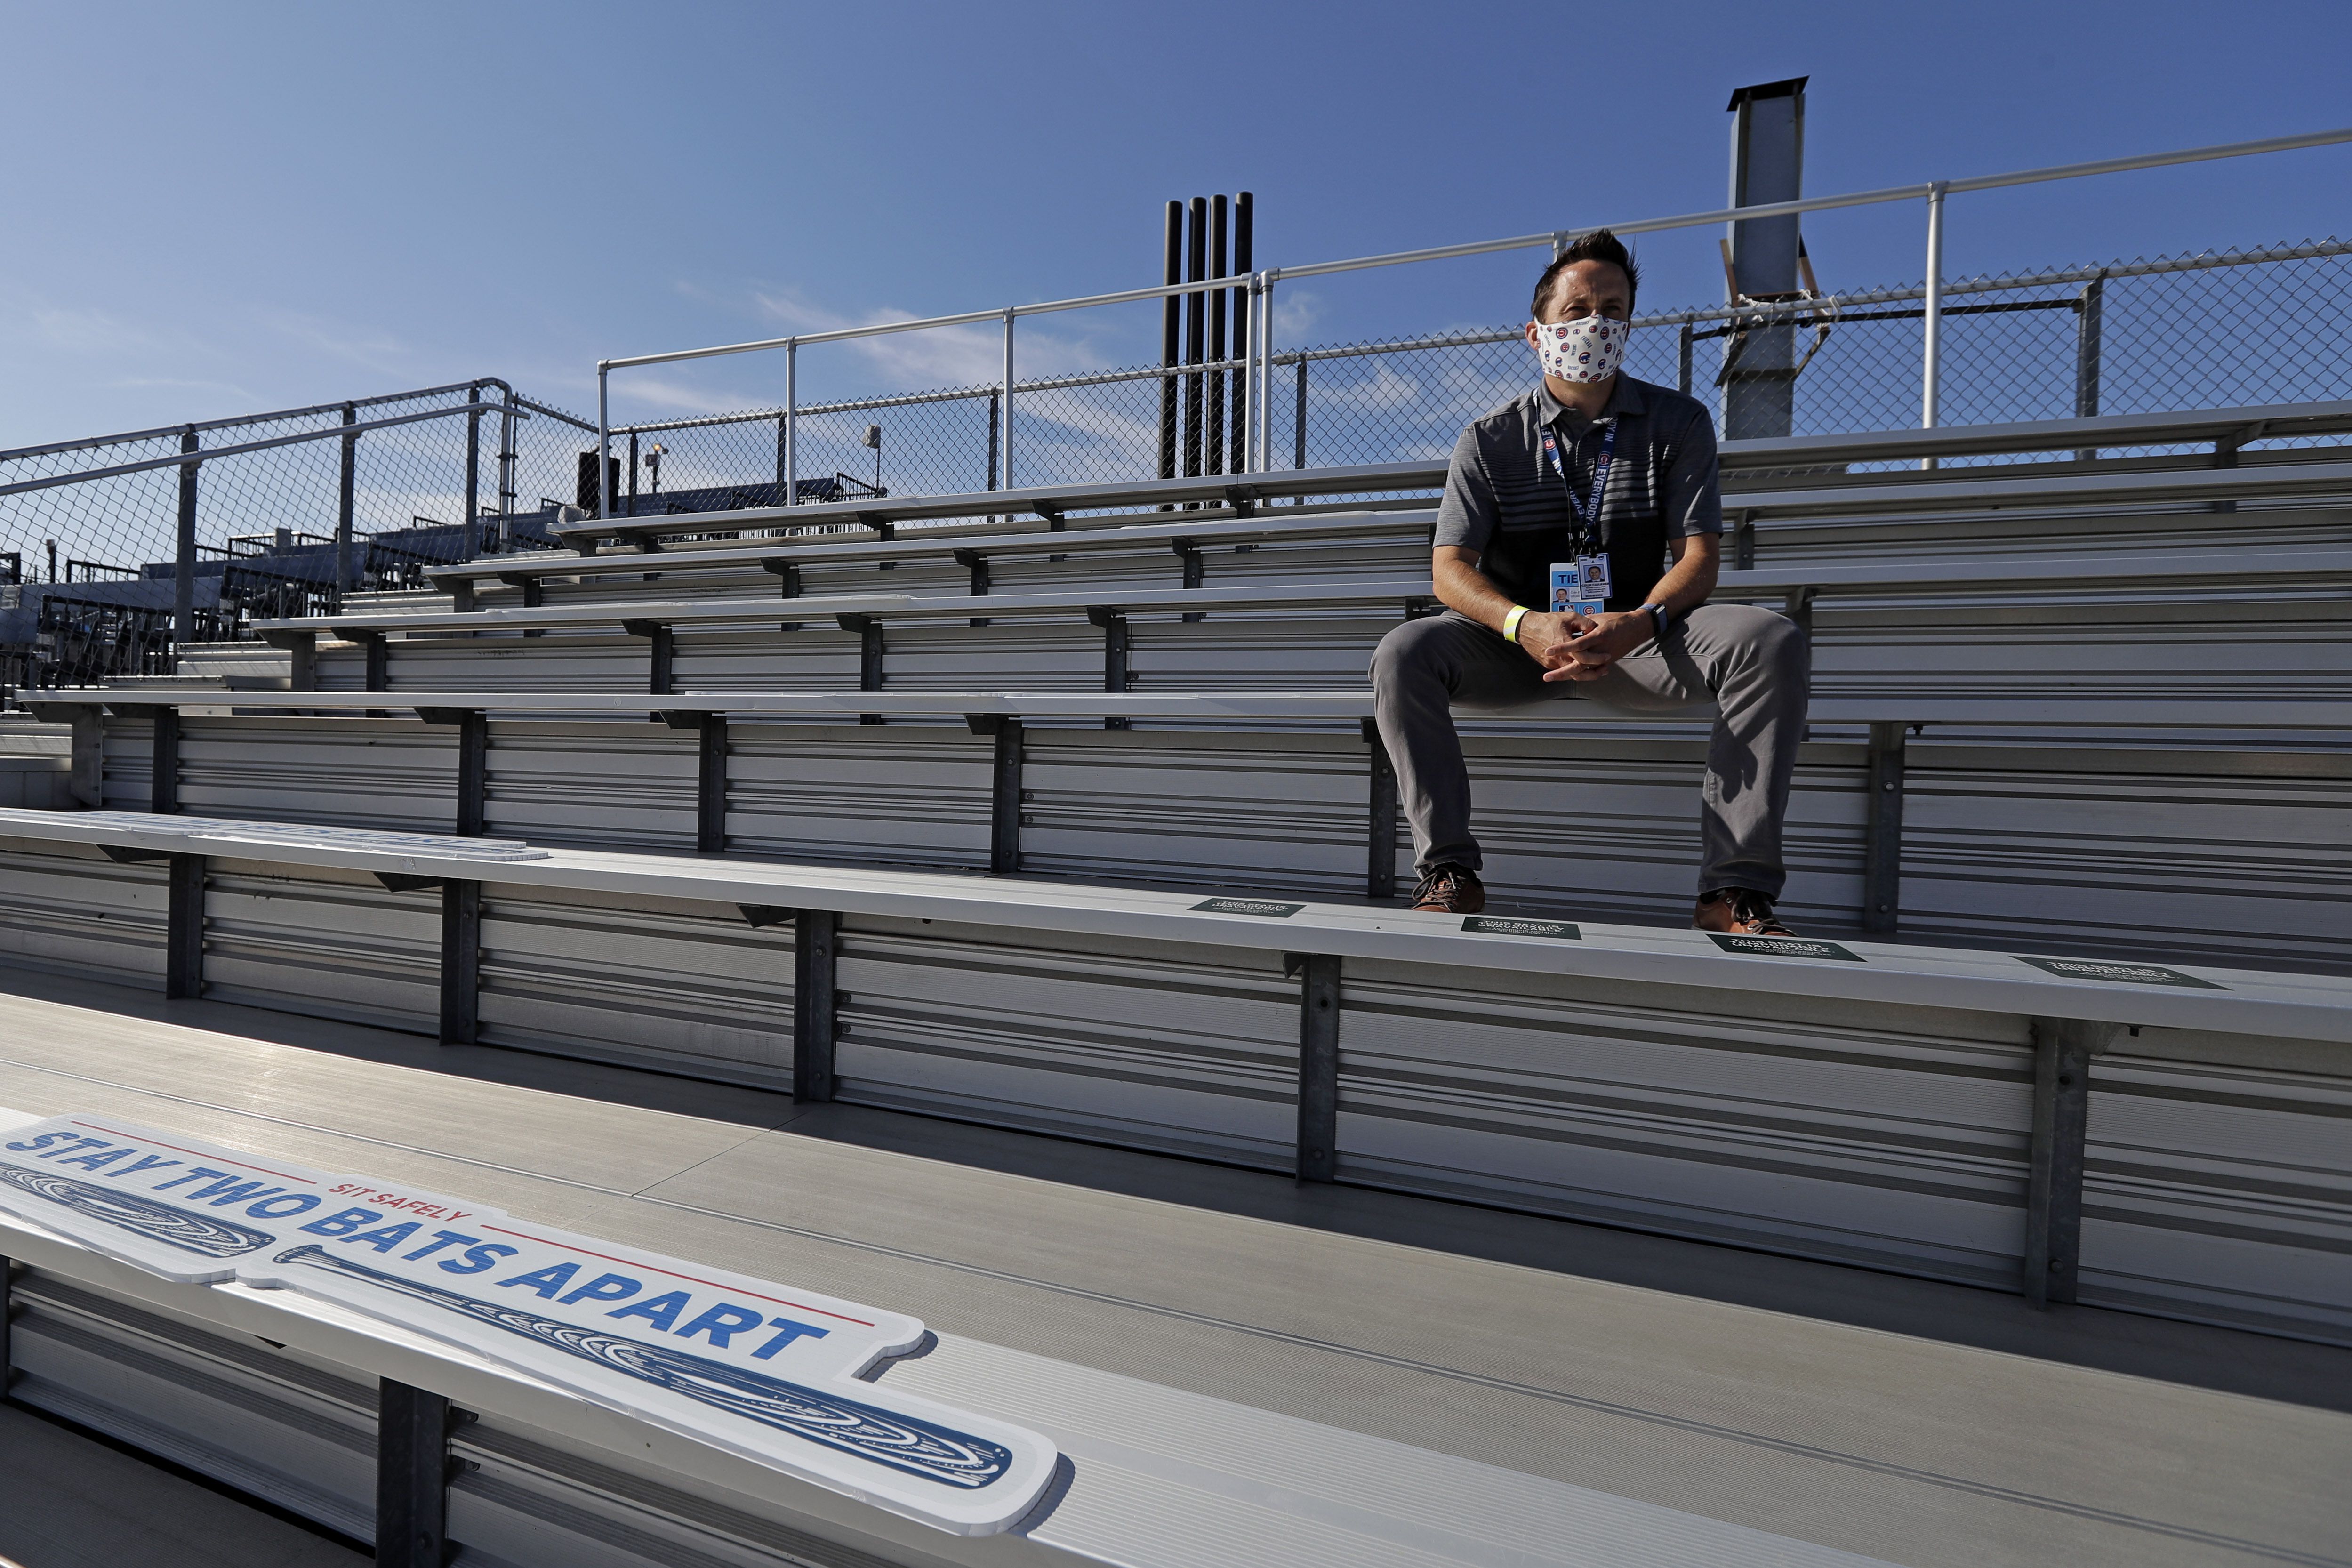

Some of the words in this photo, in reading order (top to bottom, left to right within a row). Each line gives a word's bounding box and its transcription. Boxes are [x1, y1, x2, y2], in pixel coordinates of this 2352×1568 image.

[1605, 433, 1614, 442] IN
[1586, 468, 1607, 522] EVERYBODY
[333, 833, 477, 844] APART
[329, 1183, 379, 1199] SIT
[368, 1194, 472, 1222] SAFELY
[6, 1132, 179, 1178] STAY
[151, 1167, 321, 1219] TWO
[298, 1207, 518, 1274] BATS
[494, 1262, 830, 1360] APART
